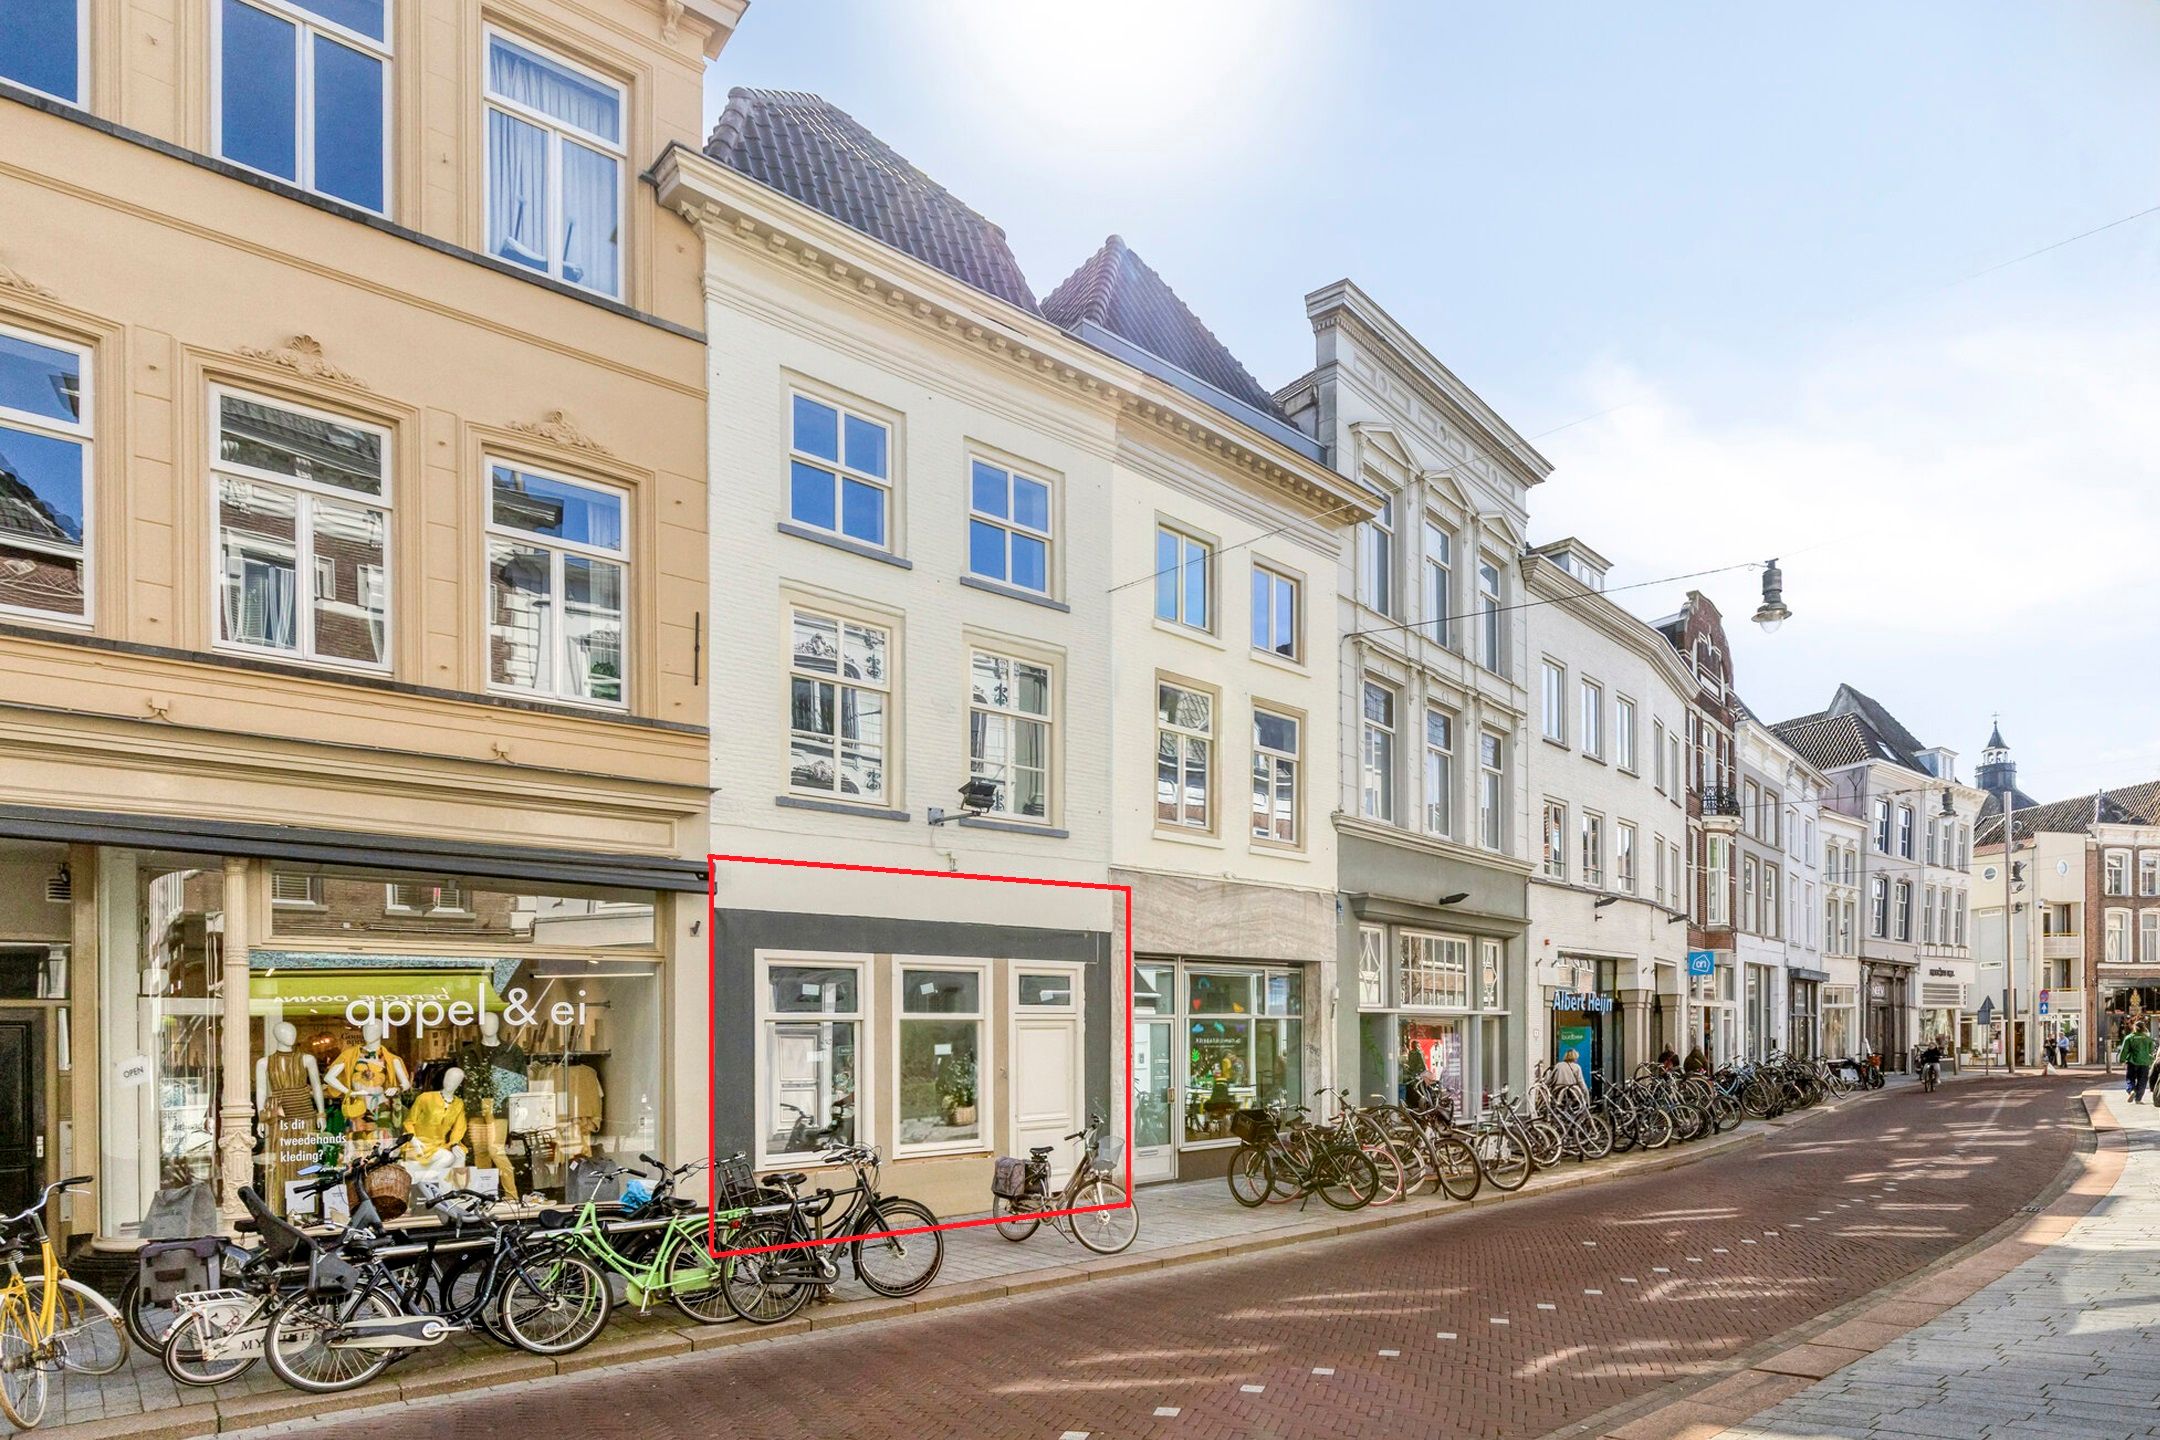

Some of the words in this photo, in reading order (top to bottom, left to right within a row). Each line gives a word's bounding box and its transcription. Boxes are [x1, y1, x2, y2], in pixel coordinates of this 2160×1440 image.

[1553, 990, 1586, 1011] Albert
[1588, 991, 1613, 1016] Heijn
[345, 983, 485, 1039] appel
[503, 987, 538, 1026] &
[550, 990, 586, 1026] ei
[123, 1066, 144, 1079] OPEN
[280, 1121, 288, 1130] Is
[291, 1119, 305, 1130] dit
[280, 1132, 347, 1146] tweedehands
[280, 1149, 324, 1163] kleding?
